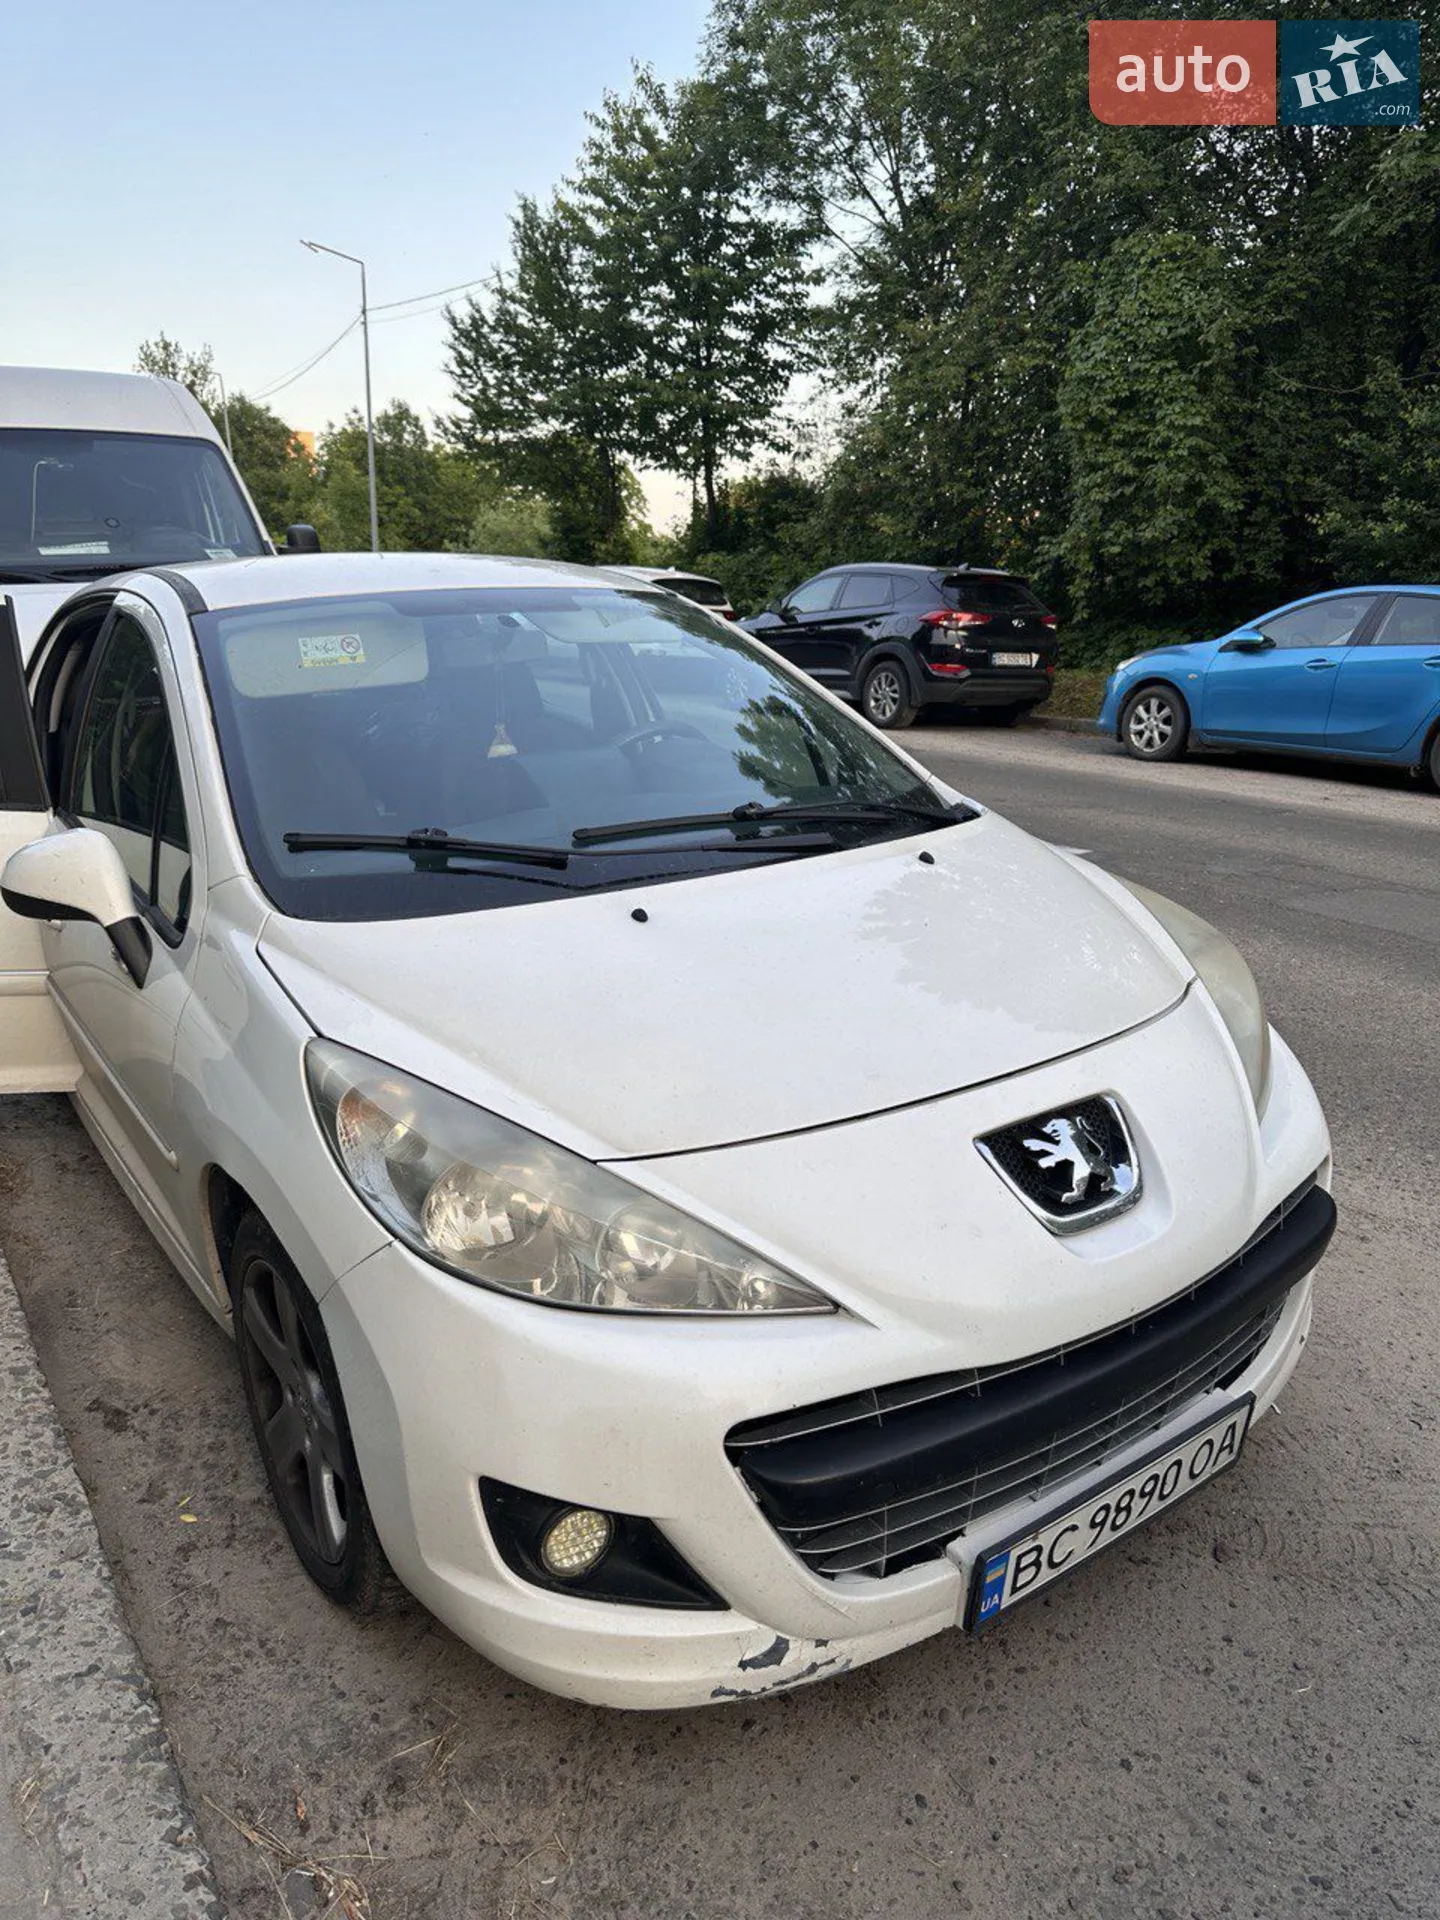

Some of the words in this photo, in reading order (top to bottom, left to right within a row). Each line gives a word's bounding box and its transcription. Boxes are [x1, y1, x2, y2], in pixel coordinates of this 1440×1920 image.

[1009, 1523, 1079, 1597] BC
[1086, 1458, 1183, 1550] 9890
[1188, 1420, 1238, 1480] OA
[980, 1593, 1000, 1613] UA
